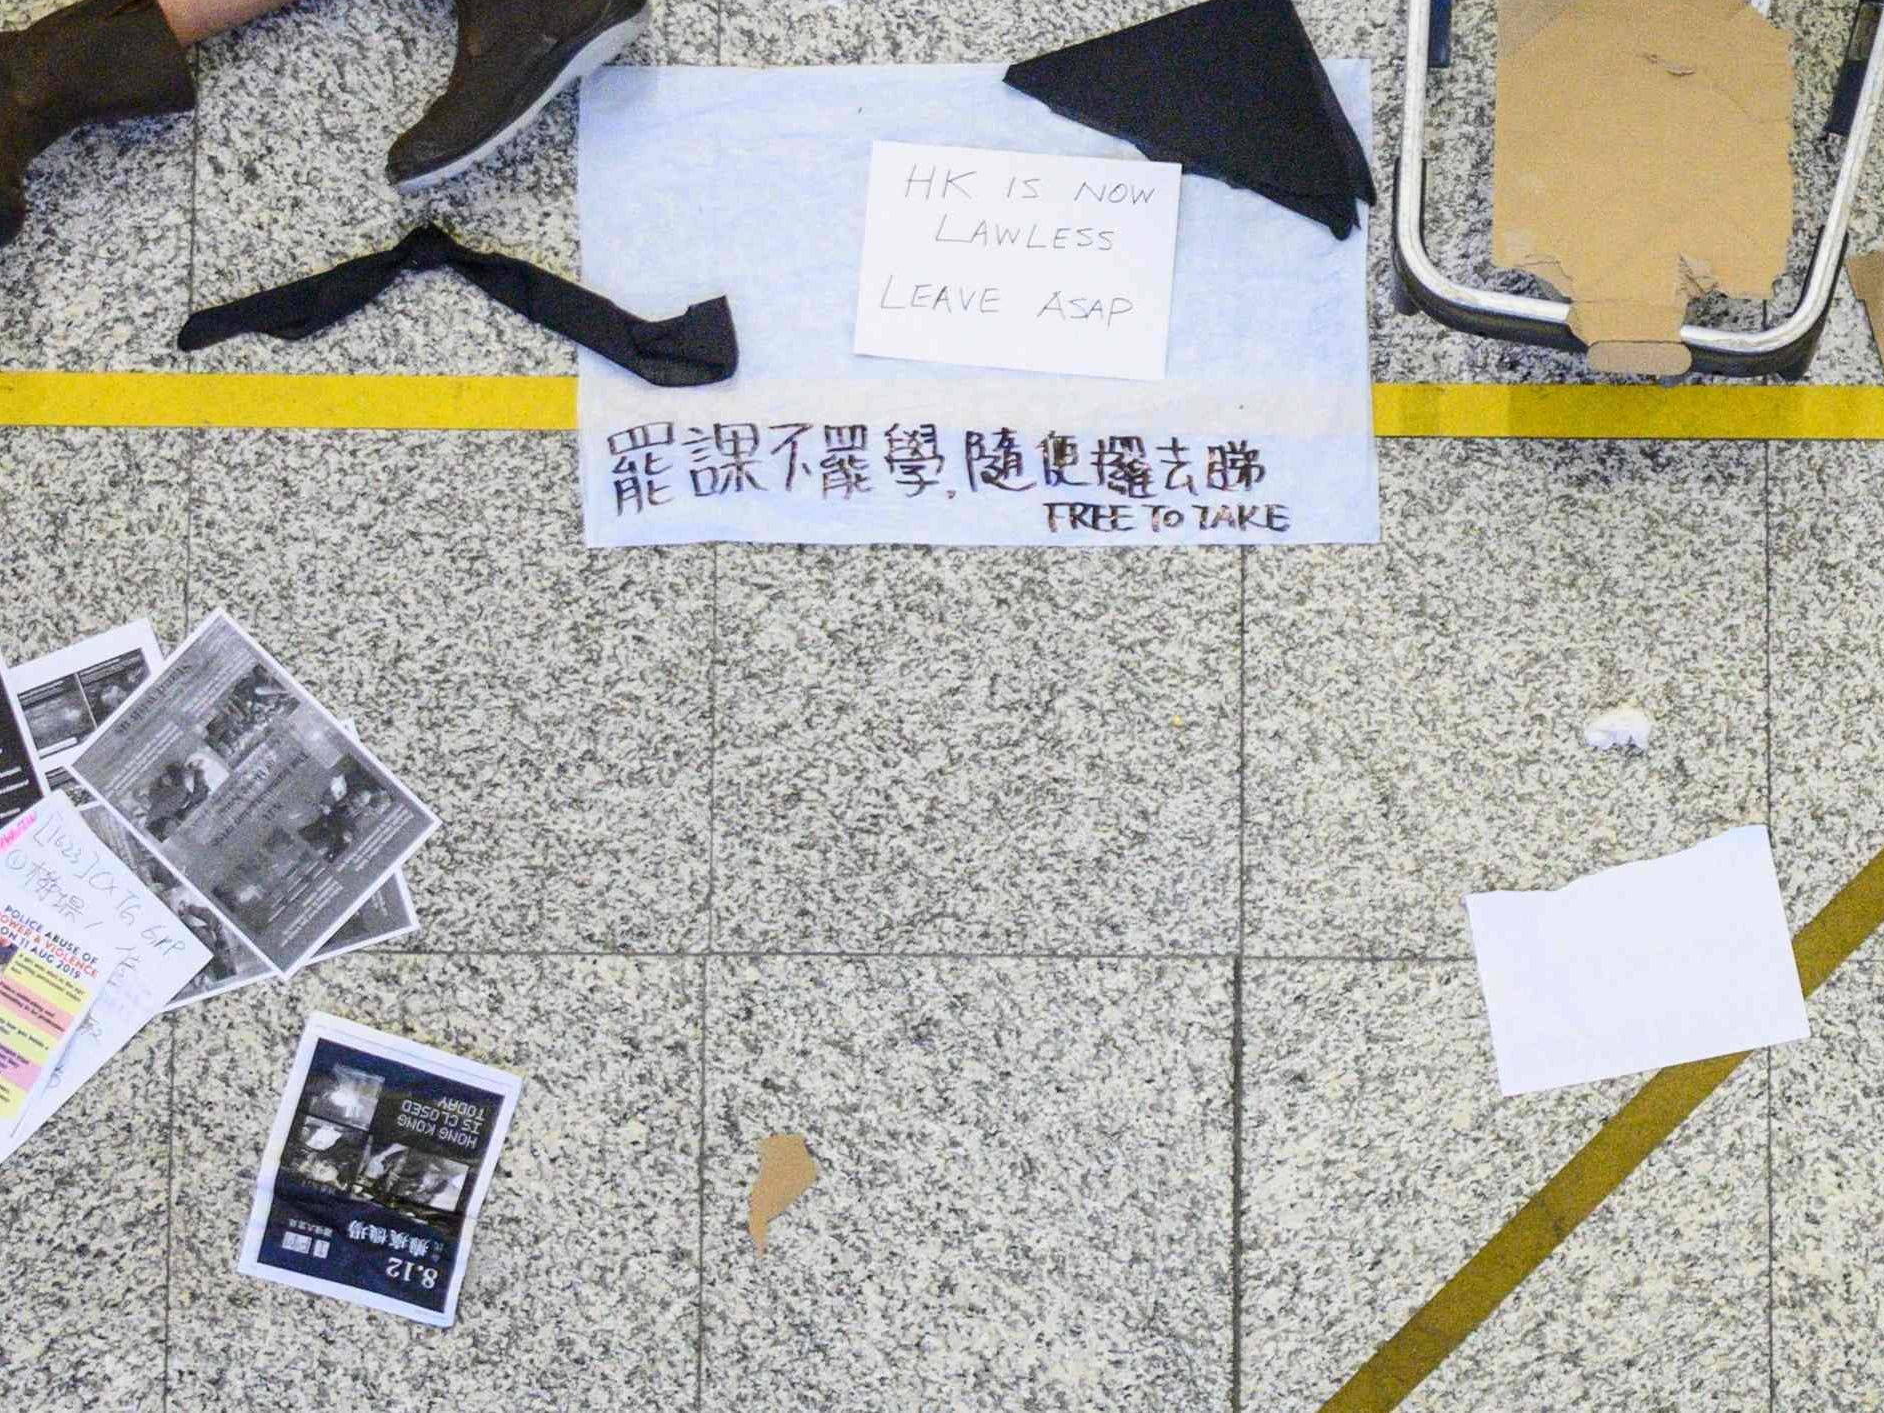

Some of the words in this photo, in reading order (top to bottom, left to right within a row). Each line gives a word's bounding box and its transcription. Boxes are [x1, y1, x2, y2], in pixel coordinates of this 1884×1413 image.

[904, 163, 978, 203] HK
[1005, 174, 1042, 202] IS
[1074, 179, 1158, 207] NOW
[934, 218, 1117, 252] LAWLESS
[879, 273, 1001, 316] LEAVE
[1036, 289, 1135, 323] ASAP
[1191, 502, 1292, 533] TAKE
[5, 904, 44, 934] POLICE
[44, 931, 80, 956] ABUSE
[81, 952, 99, 965] OF
[19, 939, 30, 950] 11
[30, 945, 55, 965] AUG
[56, 958, 82, 980] 2019
[43, 938, 99, 978] VIOLENCE
[401, 1098, 457, 1127] CLOSED
[437, 1096, 486, 1122] TODAY
[396, 1114, 437, 1138] KONG
[438, 1127, 478, 1149] HONG
[463, 1119, 483, 1134] IS
[385, 1256, 438, 1289] 8.12
